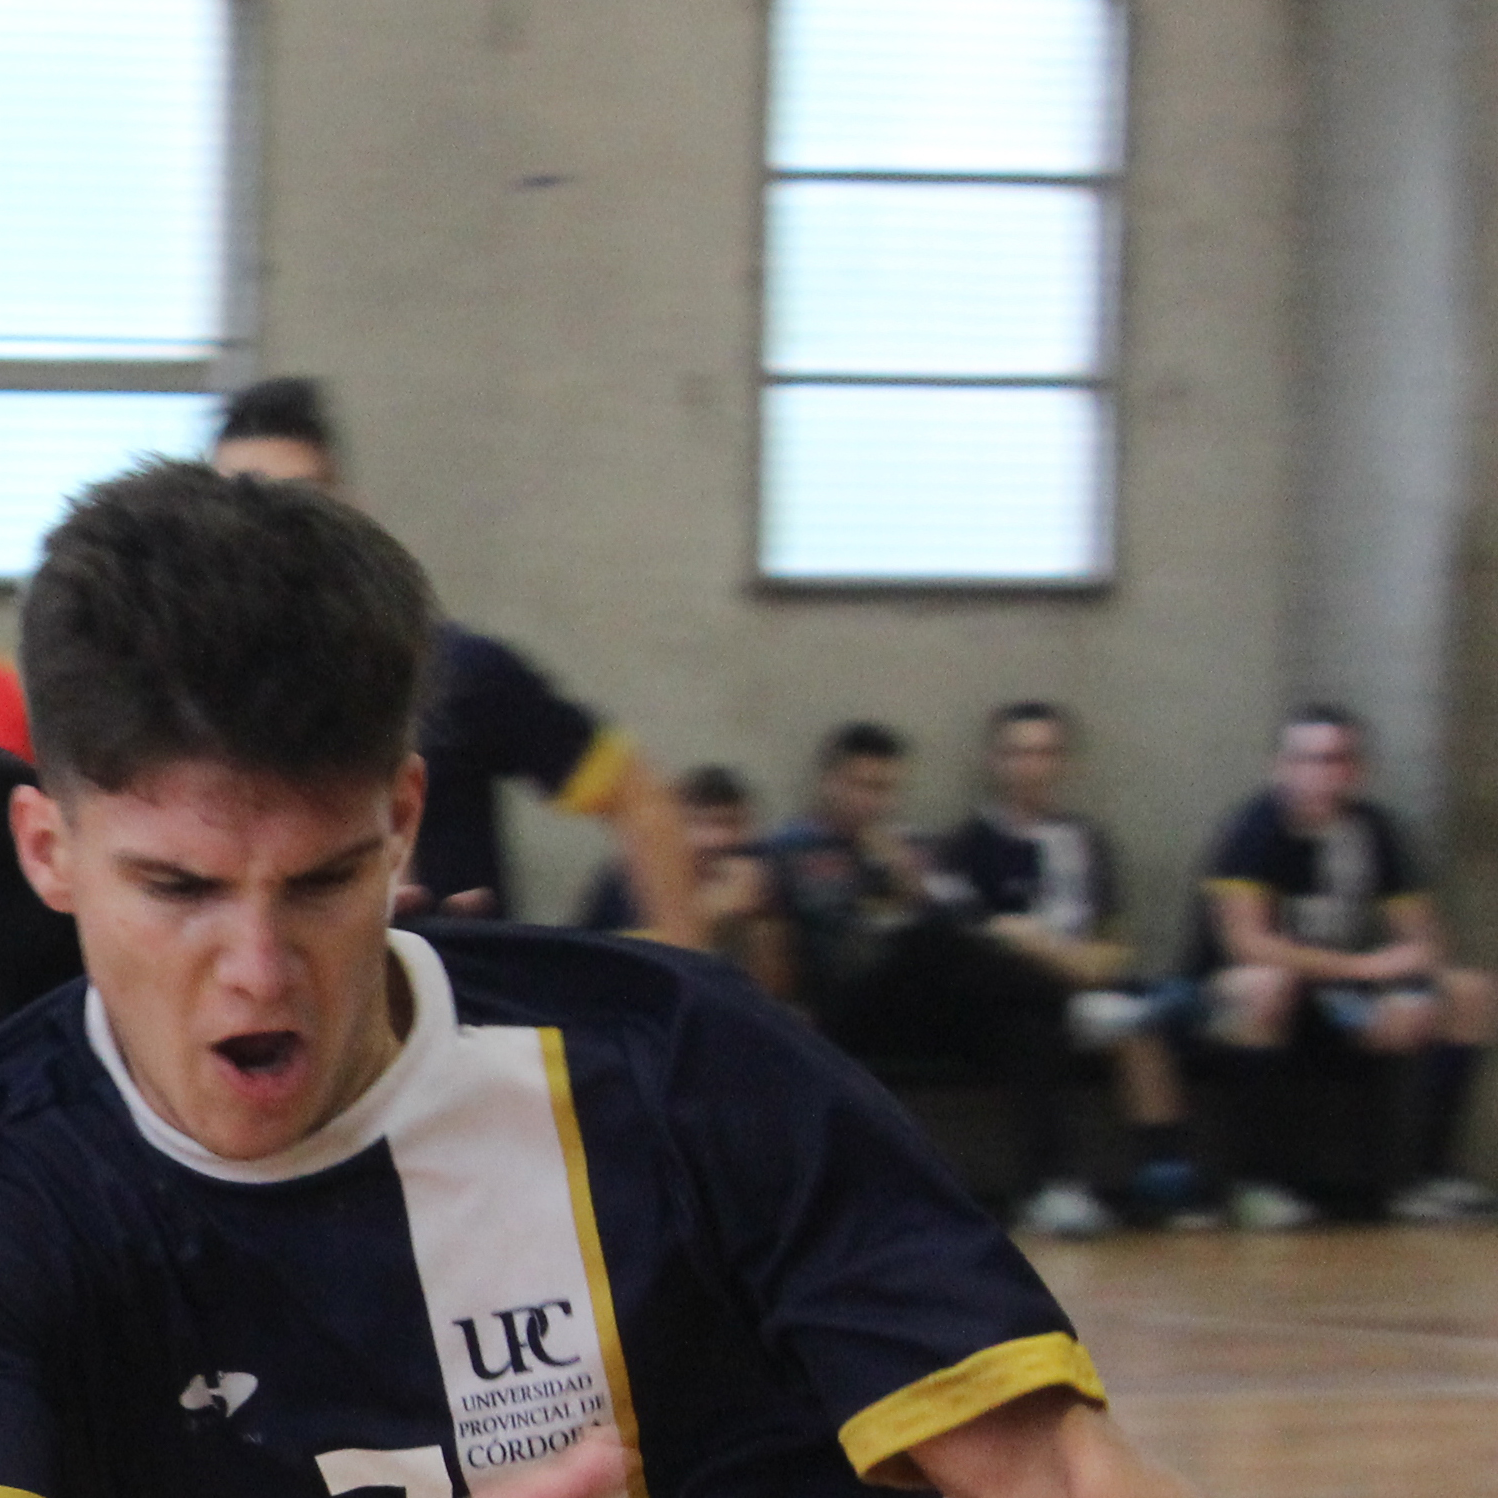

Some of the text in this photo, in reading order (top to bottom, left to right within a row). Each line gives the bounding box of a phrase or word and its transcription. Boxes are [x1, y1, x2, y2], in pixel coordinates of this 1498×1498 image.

[452, 1299, 581, 1379] UPC
[461, 1373, 592, 1411] UNIVERSIDAD
[458, 1402, 569, 1438] PROVINCIAL
